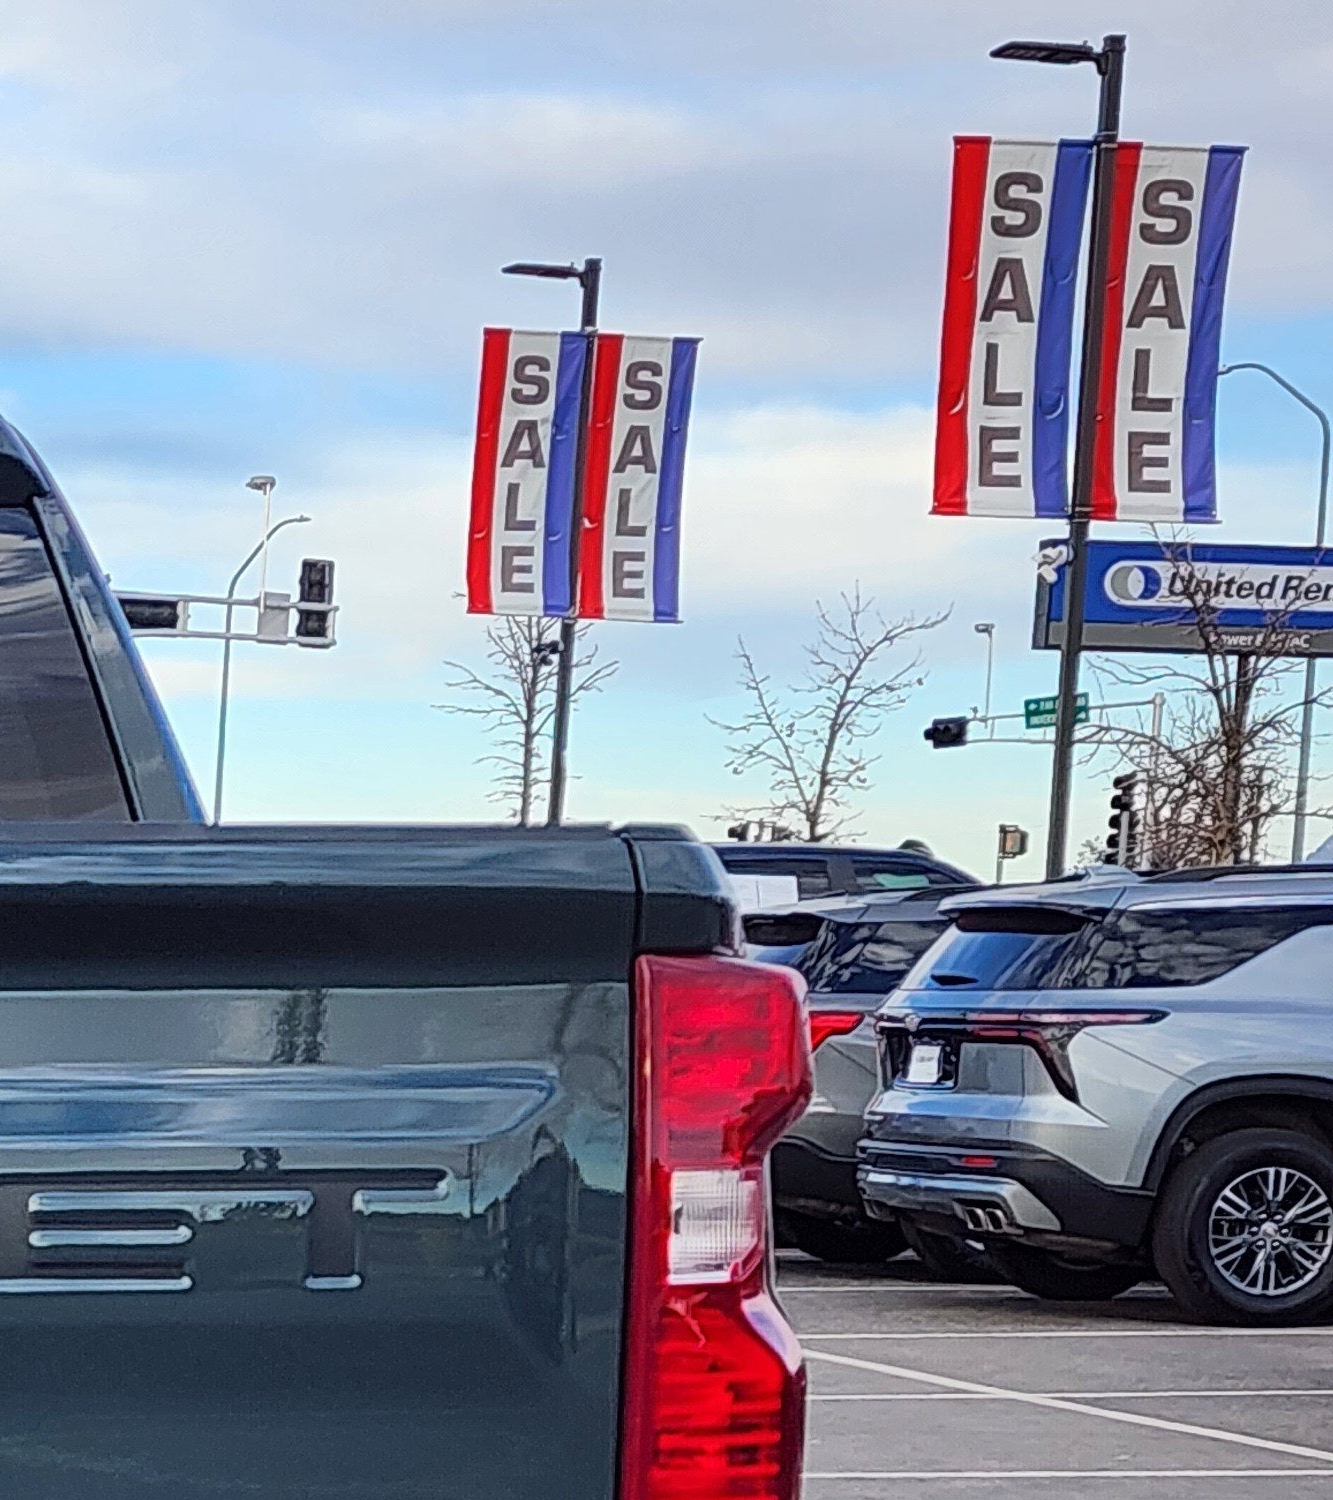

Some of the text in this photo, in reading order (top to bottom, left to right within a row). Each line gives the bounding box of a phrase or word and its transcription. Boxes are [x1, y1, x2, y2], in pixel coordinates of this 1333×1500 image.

[978, 171, 1044, 488] SALE
[1125, 179, 1195, 494] SALE
[500, 355, 551, 593] SALE
[612, 361, 664, 599] SALE
[1168, 571, 1279, 600] United
